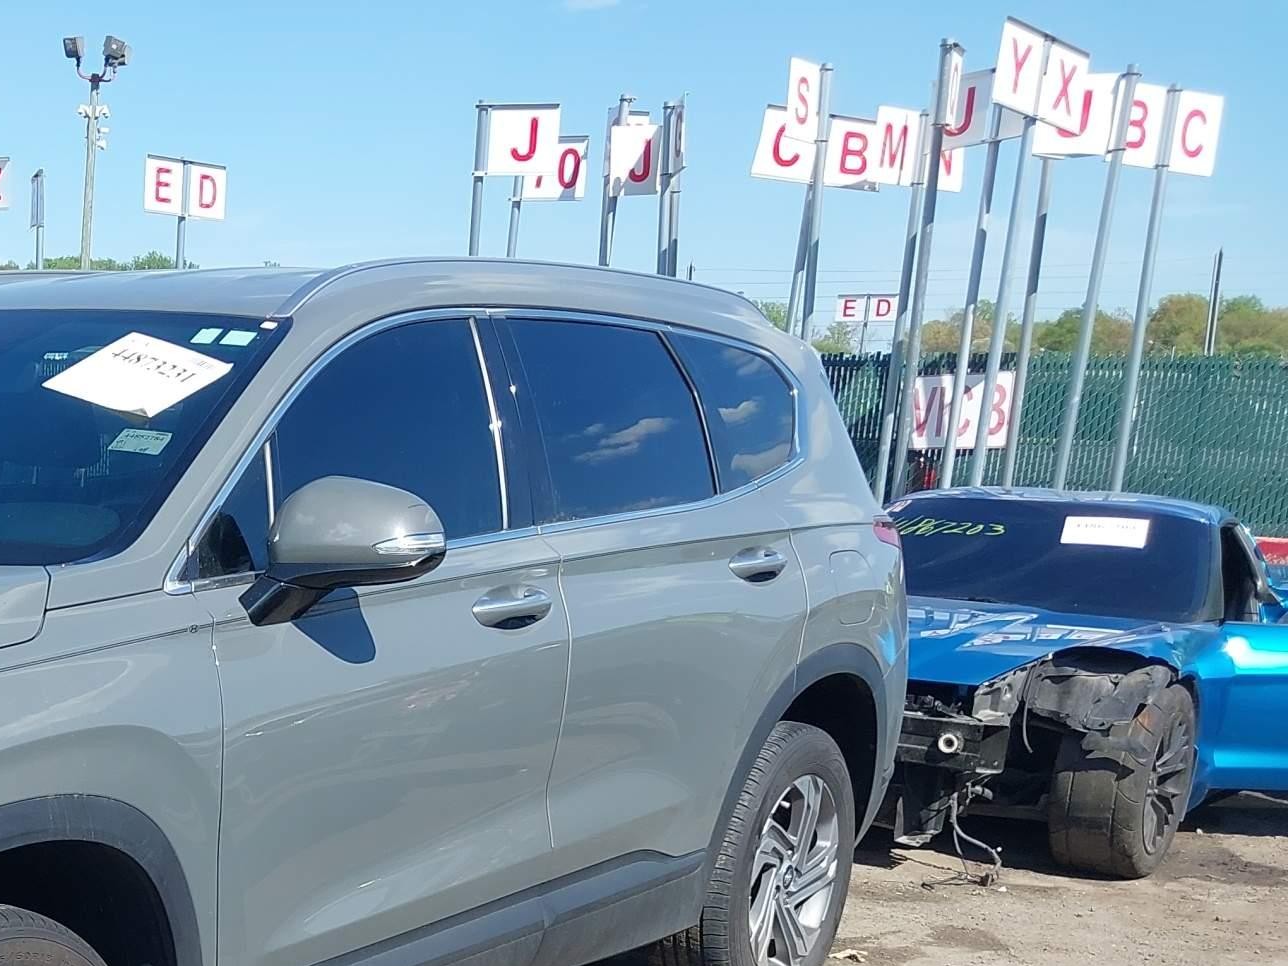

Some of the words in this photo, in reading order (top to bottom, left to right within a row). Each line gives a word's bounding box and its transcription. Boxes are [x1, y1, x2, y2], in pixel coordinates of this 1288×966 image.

[1012, 37, 1033, 94] Y
[1052, 59, 1077, 116] X
[795, 76, 810, 125] S
[510, 116, 539, 162] J
[773, 122, 800, 167] C
[839, 131, 868, 175] B
[879, 121, 908, 171] M
[1182, 109, 1207, 158] C
[628, 138, 652, 183] J
[155, 167, 172, 203] E
[199, 174, 217, 209] D
[842, 299, 857, 318] E
[876, 298, 892, 318] D
